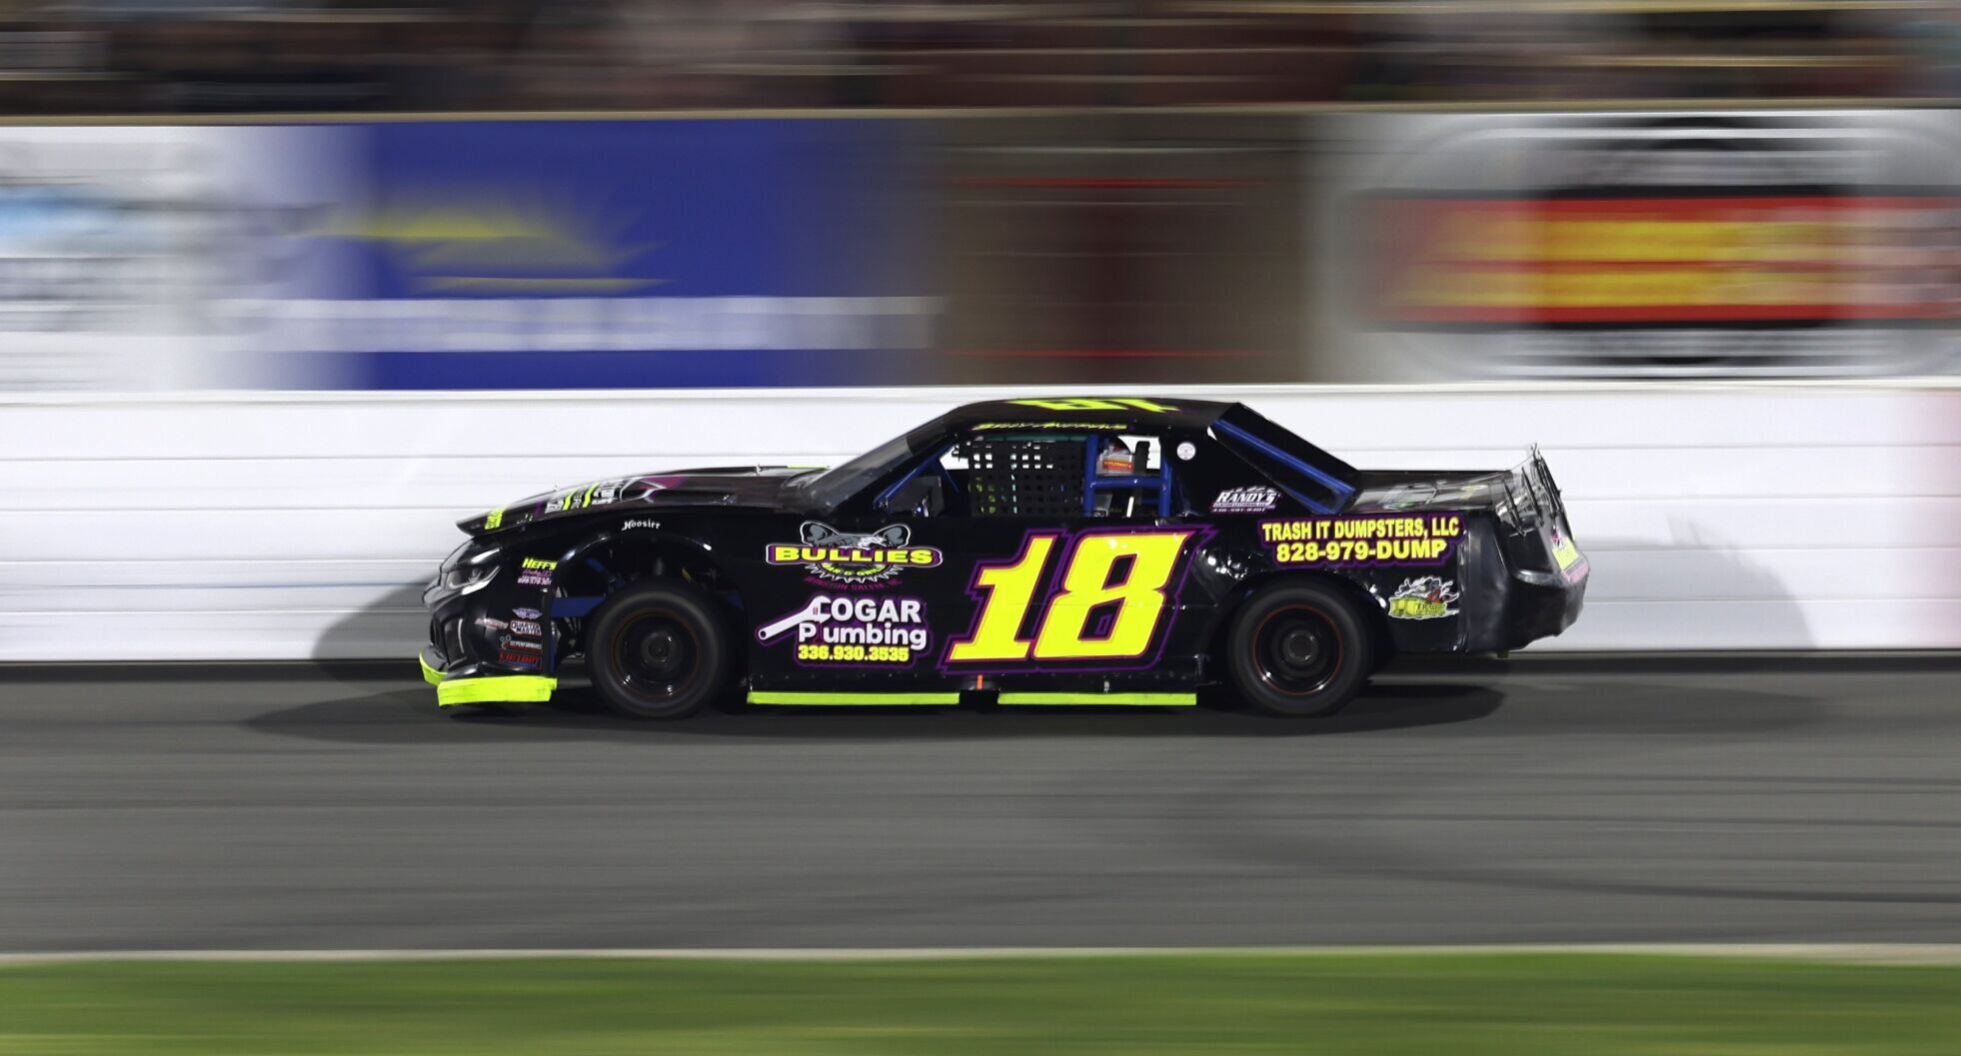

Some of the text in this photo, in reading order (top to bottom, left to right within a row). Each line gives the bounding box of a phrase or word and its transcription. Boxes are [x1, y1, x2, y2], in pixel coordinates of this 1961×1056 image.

[1262, 517, 1459, 541] TRASH IT DUMPSTERS, LLC
[775, 546, 933, 563] BULLIES
[1276, 539, 1448, 562] 828-979-DUMP
[948, 532, 1192, 661] 18
[798, 645, 910, 662] 336.930.3535
